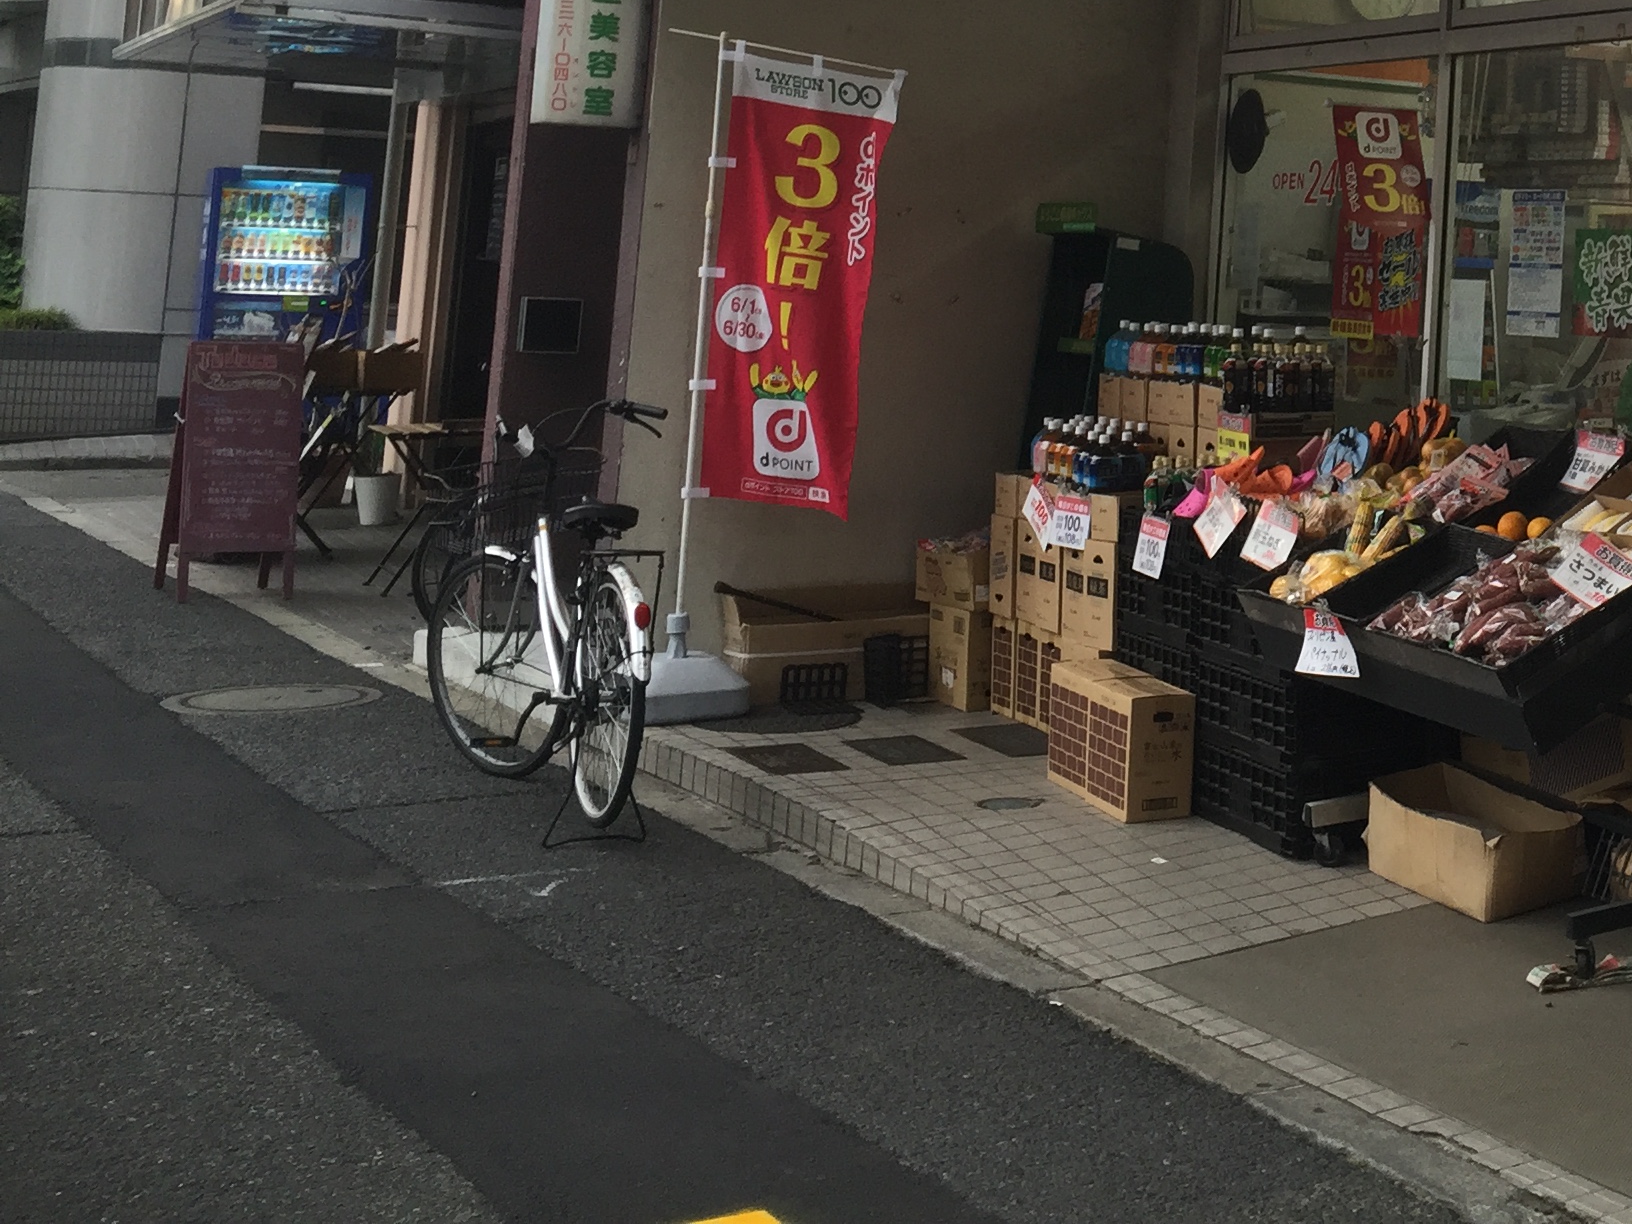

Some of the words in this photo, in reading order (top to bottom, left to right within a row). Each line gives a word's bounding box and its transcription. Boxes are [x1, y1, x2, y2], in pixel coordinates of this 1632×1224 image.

[755, 68, 824, 92] LAWSON
[770, 84, 809, 100] STORE
[827, 78, 882, 109] 100
[1272, 172, 1305, 190] OPEN
[1579, 235, 1632, 286] 新鮮
[772, 457, 814, 472] POINT
